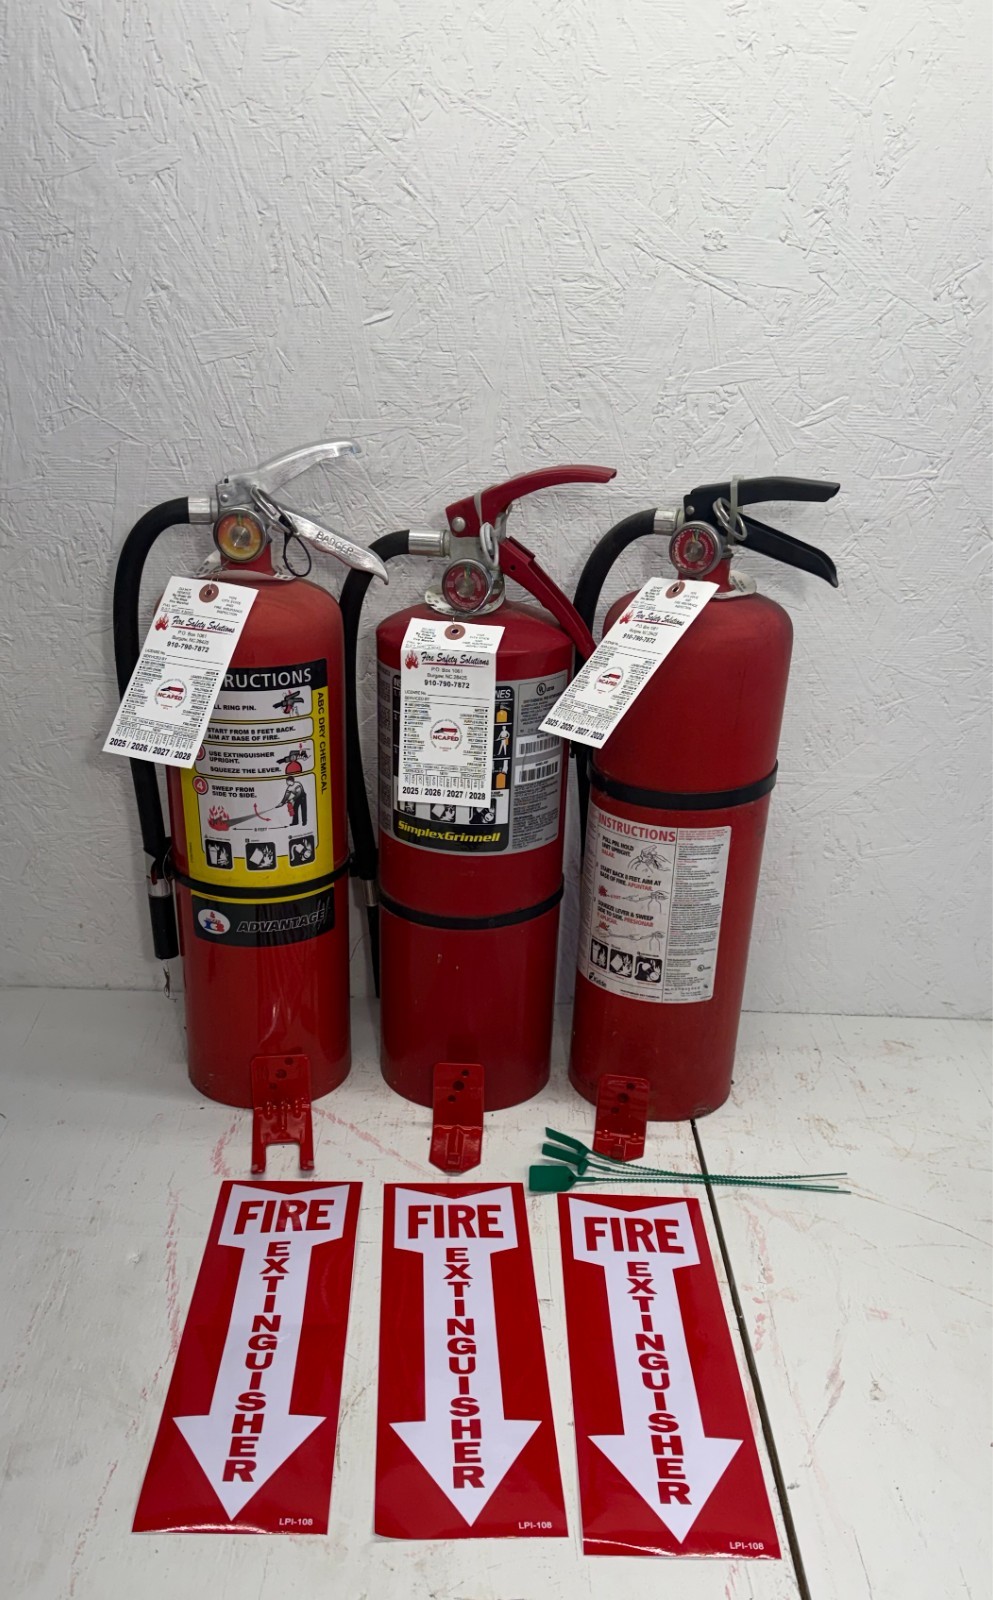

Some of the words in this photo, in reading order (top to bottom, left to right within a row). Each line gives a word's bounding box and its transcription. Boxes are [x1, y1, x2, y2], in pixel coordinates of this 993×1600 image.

[316, 531, 353, 556] BADGER
[171, 616, 184, 625] Fire
[186, 618, 206, 629] Safety
[207, 621, 235, 633] Solutions
[645, 613, 662, 623] Safety
[661, 615, 685, 626] Solutions
[421, 651, 434, 662] Fire
[437, 653, 457, 665] Safety
[460, 655, 489, 666] Solutions
[224, 668, 312, 688] RUCTIONS
[109, 738, 126, 747] 2025
[131, 742, 148, 752] 2026
[153, 746, 170, 756] 2027
[174, 751, 192, 760] 2028
[197, 779, 203, 789] 4
[402, 786, 419, 795] 2025
[424, 788, 441, 797] 2026
[446, 790, 463, 798] 2027
[469, 792, 486, 800] 2028
[398, 820, 501, 842] SimplexGrinnell
[599, 814, 676, 842] INSTRUCTIONS
[621, 842, 634, 851] HOLD
[612, 870, 624, 878] BACK
[234, 1200, 335, 1235] FIRE
[408, 1205, 504, 1239] FIRE
[584, 1217, 685, 1254] FIRE
[222, 1241, 291, 1482] EXTINGUISHER
[444, 1247, 485, 1489] EXTINGUISHER
[626, 1261, 692, 1505] EXTINGUISHER
[279, 1518, 313, 1526] LPI-108
[518, 1521, 552, 1529] LPI-108
[729, 1541, 764, 1550] LPI-108
